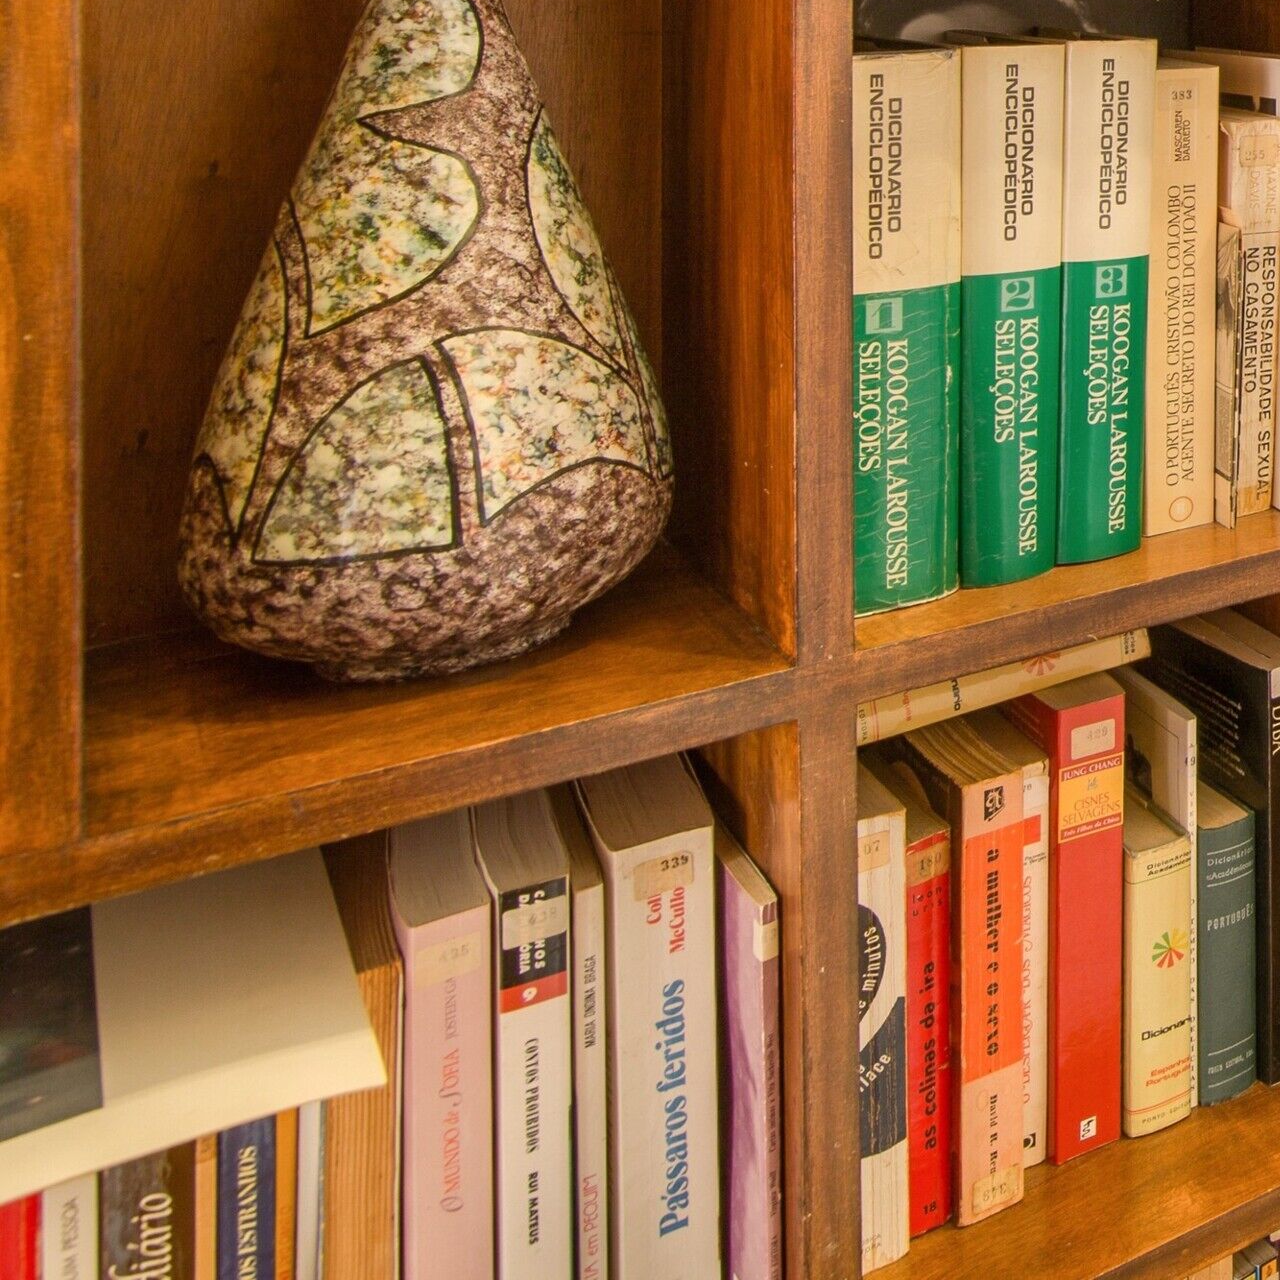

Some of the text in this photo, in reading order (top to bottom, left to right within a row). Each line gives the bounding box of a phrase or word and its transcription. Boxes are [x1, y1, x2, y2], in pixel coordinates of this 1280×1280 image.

[868, 73, 888, 260] ENCICLOPÉDICO
[887, 98, 902, 233] DICIONÁRIO
[1004, 63, 1021, 242] ENCICLOPÉDICO
[1021, 86, 1035, 217] DICIONÁRIO
[1099, 58, 1116, 230] ENCICLOPÉDICO
[1115, 80, 1129, 206] DICIONÁRIO
[1250, 171, 1259, 207] DAVIS
[1265, 164, 1276, 214] MAXINE
[989, 319, 1020, 443] SELEÇÕES
[1083, 305, 1110, 425] SELEÇÕES
[1163, 185, 1181, 487] O PORTUGUÊS CRISTÓVÃO COLOMBO
[1180, 196, 1197, 483] AGENTE SECRETO DO REI DOM JOÃO
[1244, 247, 1260, 393] NO CASAMENTO
[1257, 246, 1277, 501] RESPONSABILIDADE SEXUAL
[852, 341, 885, 472] SELEÇÕES
[886, 339, 908, 589] KOOGAN LAROUSSE
[1018, 315, 1039, 556] KOOGAN LAROUSSE
[1108, 302, 1131, 535] KOOGAN LAROUSSE
[1062, 800, 1120, 828] SELVAGENS
[1064, 758, 1120, 780] JUNG CHANG
[1074, 792, 1109, 811] CISNES
[584, 954, 597, 1049] MARIA BRAGA
[986, 870, 1002, 1056] mulher sexo
[438, 1049, 464, 1195] MUNDO SOFIA
[655, 978, 689, 1238] Pássaros feridos
[919, 961, 936, 1150] as colinas da ira
[990, 1094, 998, 1129] David
[238, 1145, 257, 1256] ESTRANHOS
[524, 1037, 540, 1245] CONTOS PROIBIDOS RUI MATEUS
[584, 1173, 598, 1233] PEQUIM
